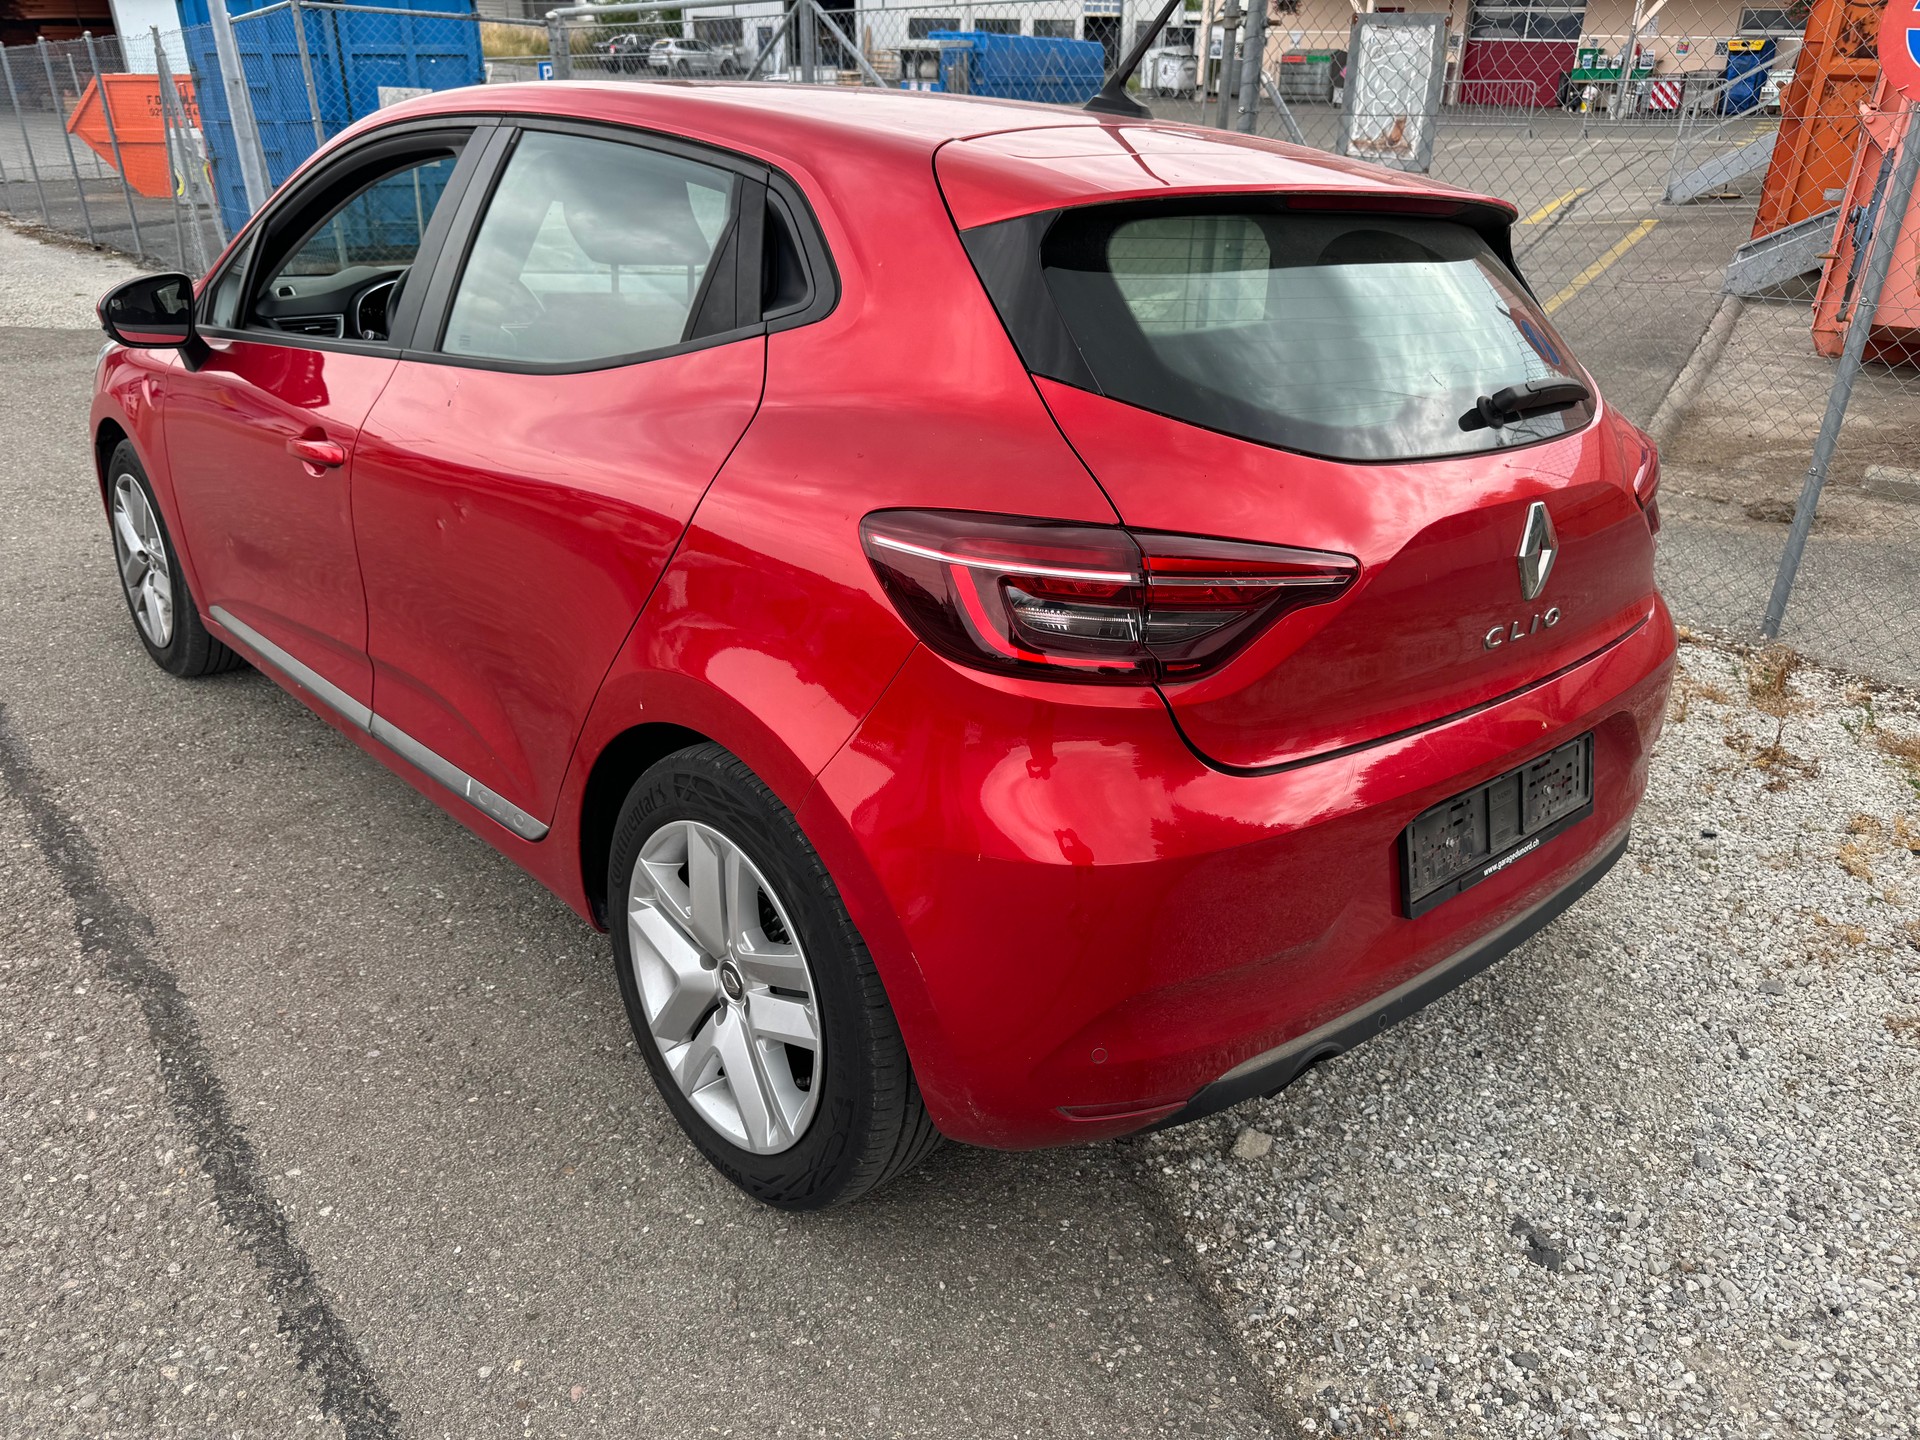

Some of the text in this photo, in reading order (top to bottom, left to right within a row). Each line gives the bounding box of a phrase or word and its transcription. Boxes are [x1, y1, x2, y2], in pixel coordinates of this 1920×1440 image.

[542, 65, 553, 80] P
[1483, 607, 1561, 650] CLIO
[477, 790, 525, 829] CLIO
[610, 787, 658, 889] Continental
[1483, 838, 1540, 876] www.garagedunord.ch
